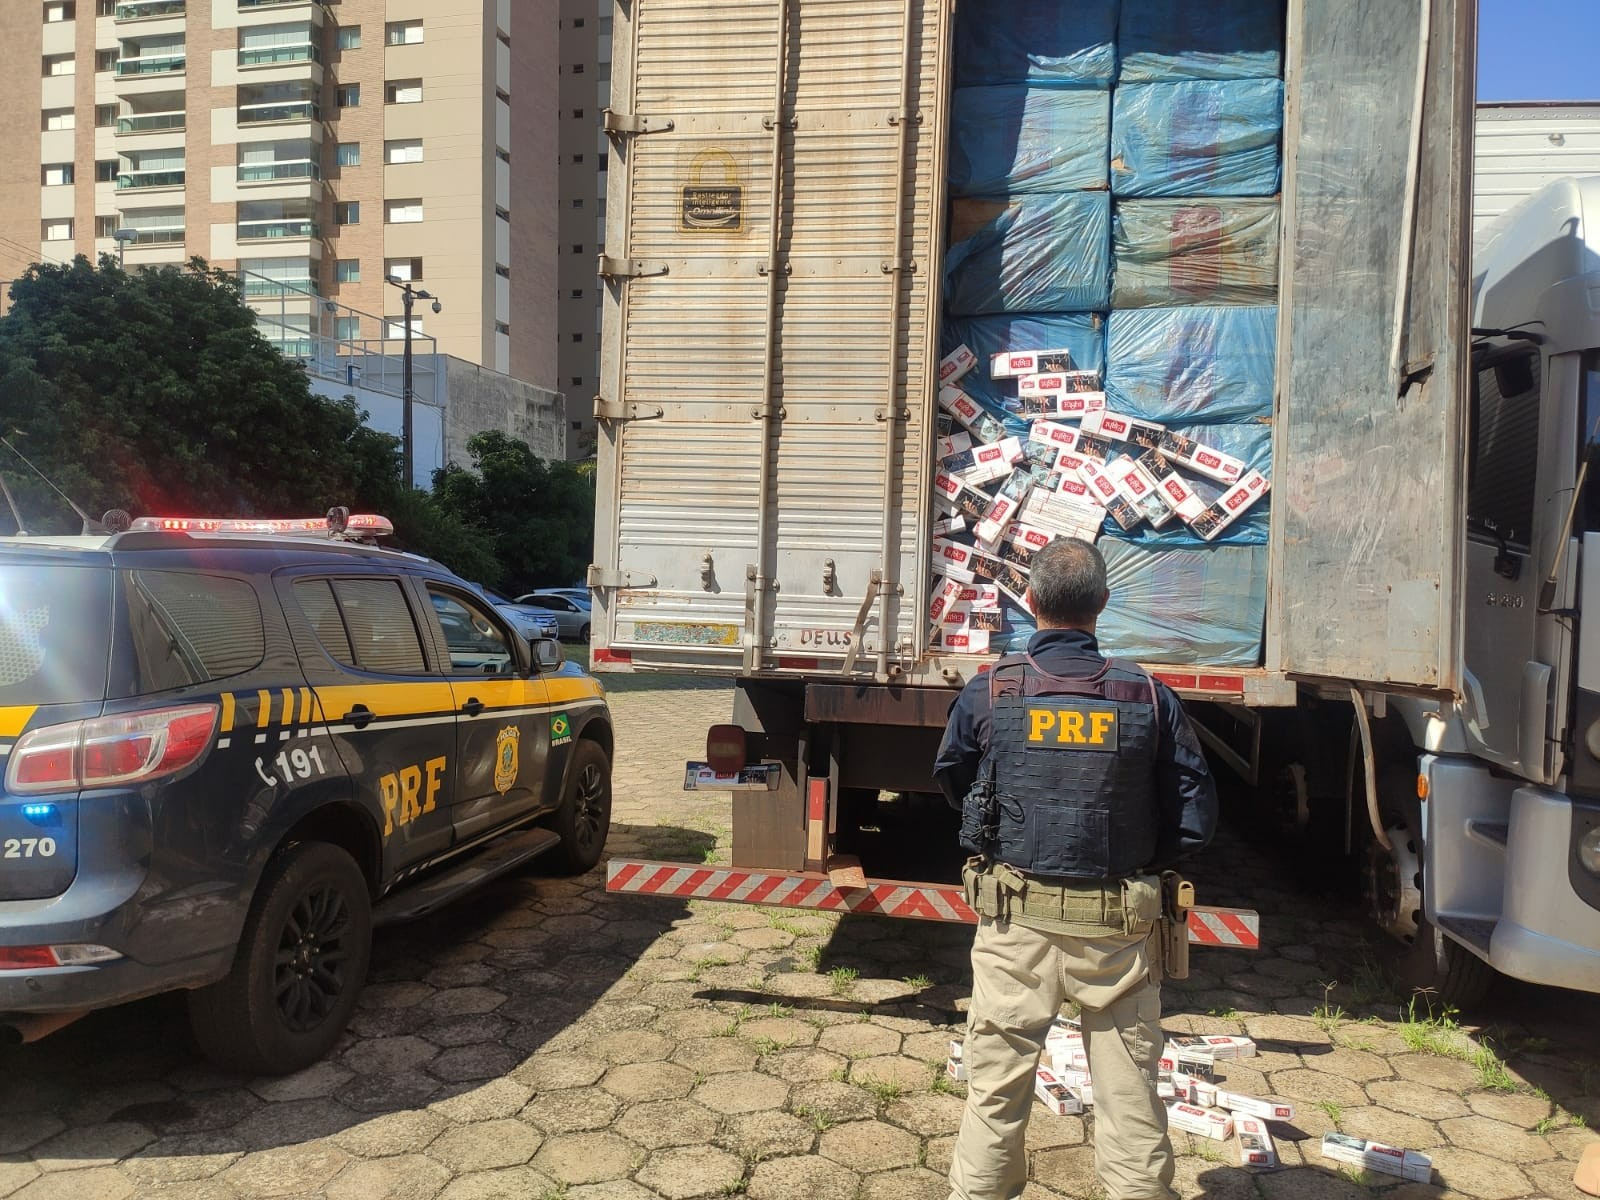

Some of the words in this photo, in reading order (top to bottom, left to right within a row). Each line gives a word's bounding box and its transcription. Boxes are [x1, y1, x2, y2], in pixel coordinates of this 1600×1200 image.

[1012, 358, 1030, 367] Eight
[1199, 453, 1218, 468] Eight
[1028, 709, 1115, 744] PRF
[551, 735, 573, 747] BRASIL
[276, 745, 326, 783] 191
[380, 755, 446, 837] PRF
[4, 837, 56, 858] 270
